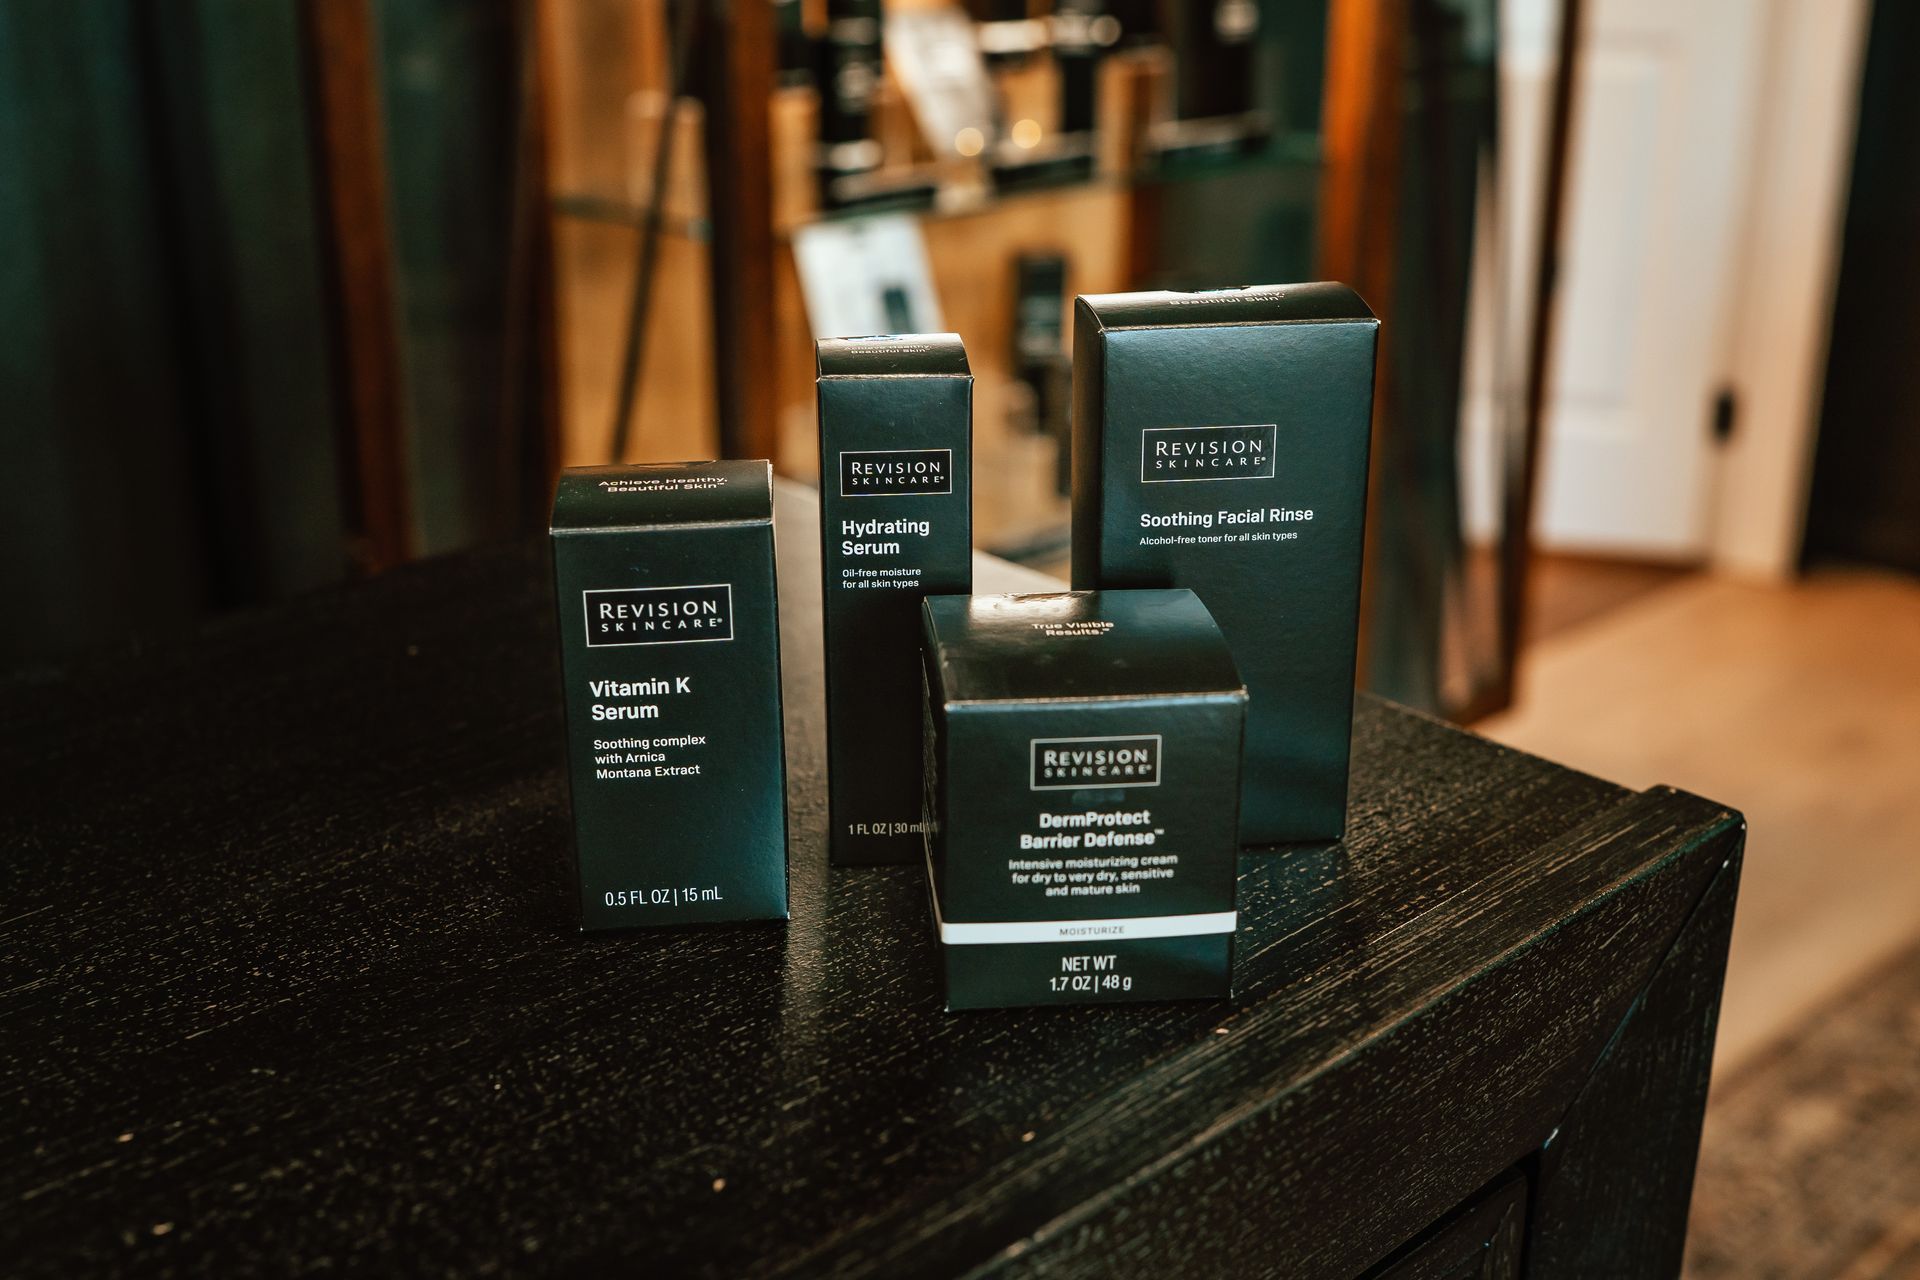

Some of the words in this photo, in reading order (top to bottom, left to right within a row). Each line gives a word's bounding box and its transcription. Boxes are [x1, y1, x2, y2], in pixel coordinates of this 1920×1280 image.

[1156, 439, 1262, 456] REVISION
[852, 461, 940, 475] REVISION
[598, 479, 661, 487] Achieve
[607, 484, 679, 493] Beautiful
[1140, 511, 1213, 529] Soothing
[1217, 508, 1265, 525] Facial
[1269, 507, 1314, 522] Rinse
[842, 518, 930, 538] Hydrating
[1139, 535, 1196, 546] Alcohol-free
[1198, 535, 1222, 543] toner
[1224, 533, 1237, 542] for
[1239, 533, 1250, 541] all
[1251, 532, 1271, 541] skin
[1272, 531, 1298, 542] types
[841, 540, 900, 556] Serum
[842, 568, 878, 578] Oil-free
[879, 567, 922, 577] moisture
[842, 580, 856, 589] for
[858, 579, 869, 589] all
[871, 579, 891, 588] skin
[893, 579, 920, 589] types
[599, 600, 718, 620] REVISION
[1065, 621, 1114, 629] Visible
[589, 677, 670, 698] Vitamin
[675, 676, 691, 694] K
[591, 703, 660, 721] Serum
[593, 736, 650, 750] Soothing
[652, 734, 707, 748] complex
[595, 753, 623, 765] with
[625, 752, 666, 764] Arnica
[1043, 748, 1149, 767] REVISION
[596, 767, 652, 779] Montana
[654, 764, 701, 777] Extract
[1039, 809, 1151, 829] DermProtect
[848, 824, 854, 835] 1
[857, 823, 870, 835] FL
[872, 823, 887, 835] OZ
[894, 822, 908, 834] 30
[1019, 832, 1081, 850] Barrier
[1008, 858, 1064, 871] Intensive
[1065, 856, 1139, 869] moisturizing
[1140, 855, 1179, 866] cream
[1012, 873, 1029, 885] for
[1031, 872, 1052, 885] dry
[1053, 872, 1067, 884] to
[1068, 871, 1094, 885] very
[1096, 869, 1119, 883] dry,
[1120, 867, 1174, 881] sensitive
[605, 891, 627, 907] 0.5
[630, 890, 648, 905] FL
[651, 888, 671, 904] OZ
[681, 887, 698, 902] 15
[701, 885, 723, 901] mL
[1045, 885, 1069, 897] and
[1070, 884, 1114, 896] mature
[1115, 882, 1140, 895] skin
[1059, 925, 1125, 936] MOISTURIZE
[1061, 956, 1091, 972] NET
[1092, 955, 1117, 971] WT
[1049, 976, 1069, 992] 1.7
[1071, 975, 1091, 991] OZ
[1101, 974, 1120, 989] 48
[1122, 976, 1132, 991] g
